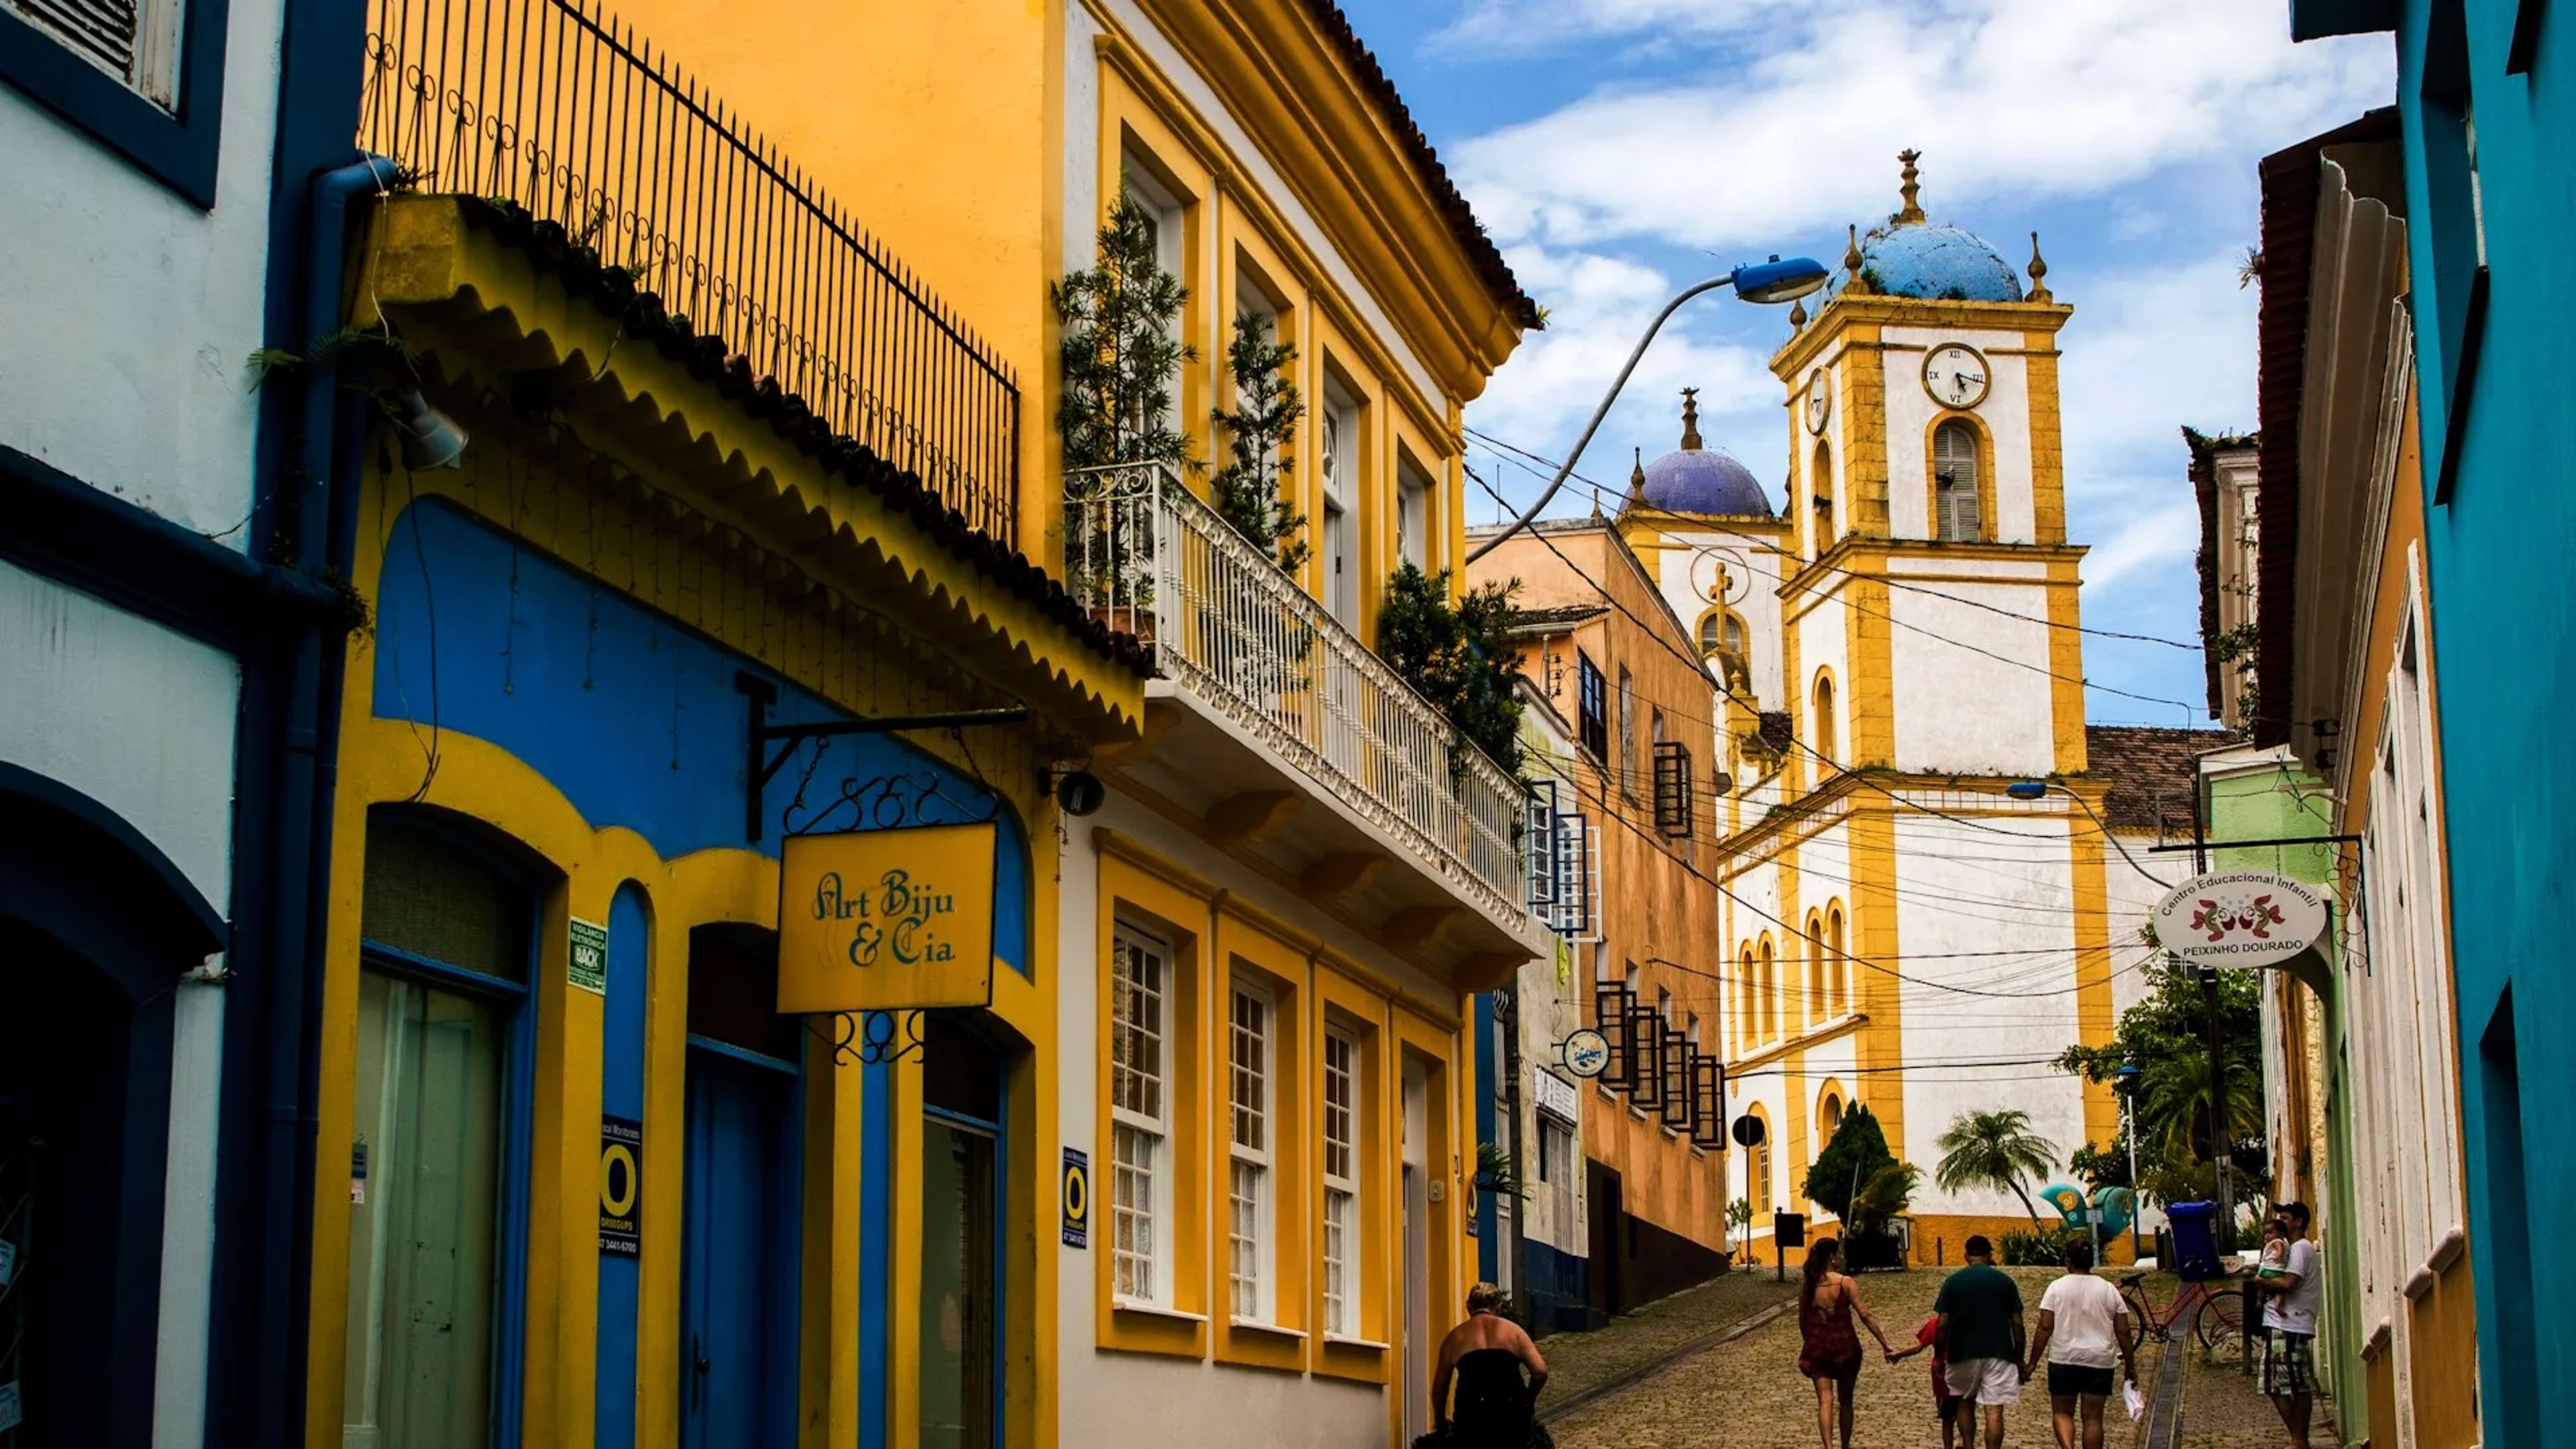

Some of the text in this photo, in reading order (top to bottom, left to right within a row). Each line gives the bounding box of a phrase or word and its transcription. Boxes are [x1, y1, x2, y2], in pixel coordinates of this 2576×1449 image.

[1949, 350, 1960, 358] XII
[1929, 371, 1939, 380] IX
[1950, 394, 1961, 402] VI
[812, 869, 955, 924] Art Biju
[2161, 872, 2318, 916] Centro Educacional Infantil
[849, 916, 956, 967] & Cia
[2184, 940, 2304, 957] PEIXINHO DOURADO
